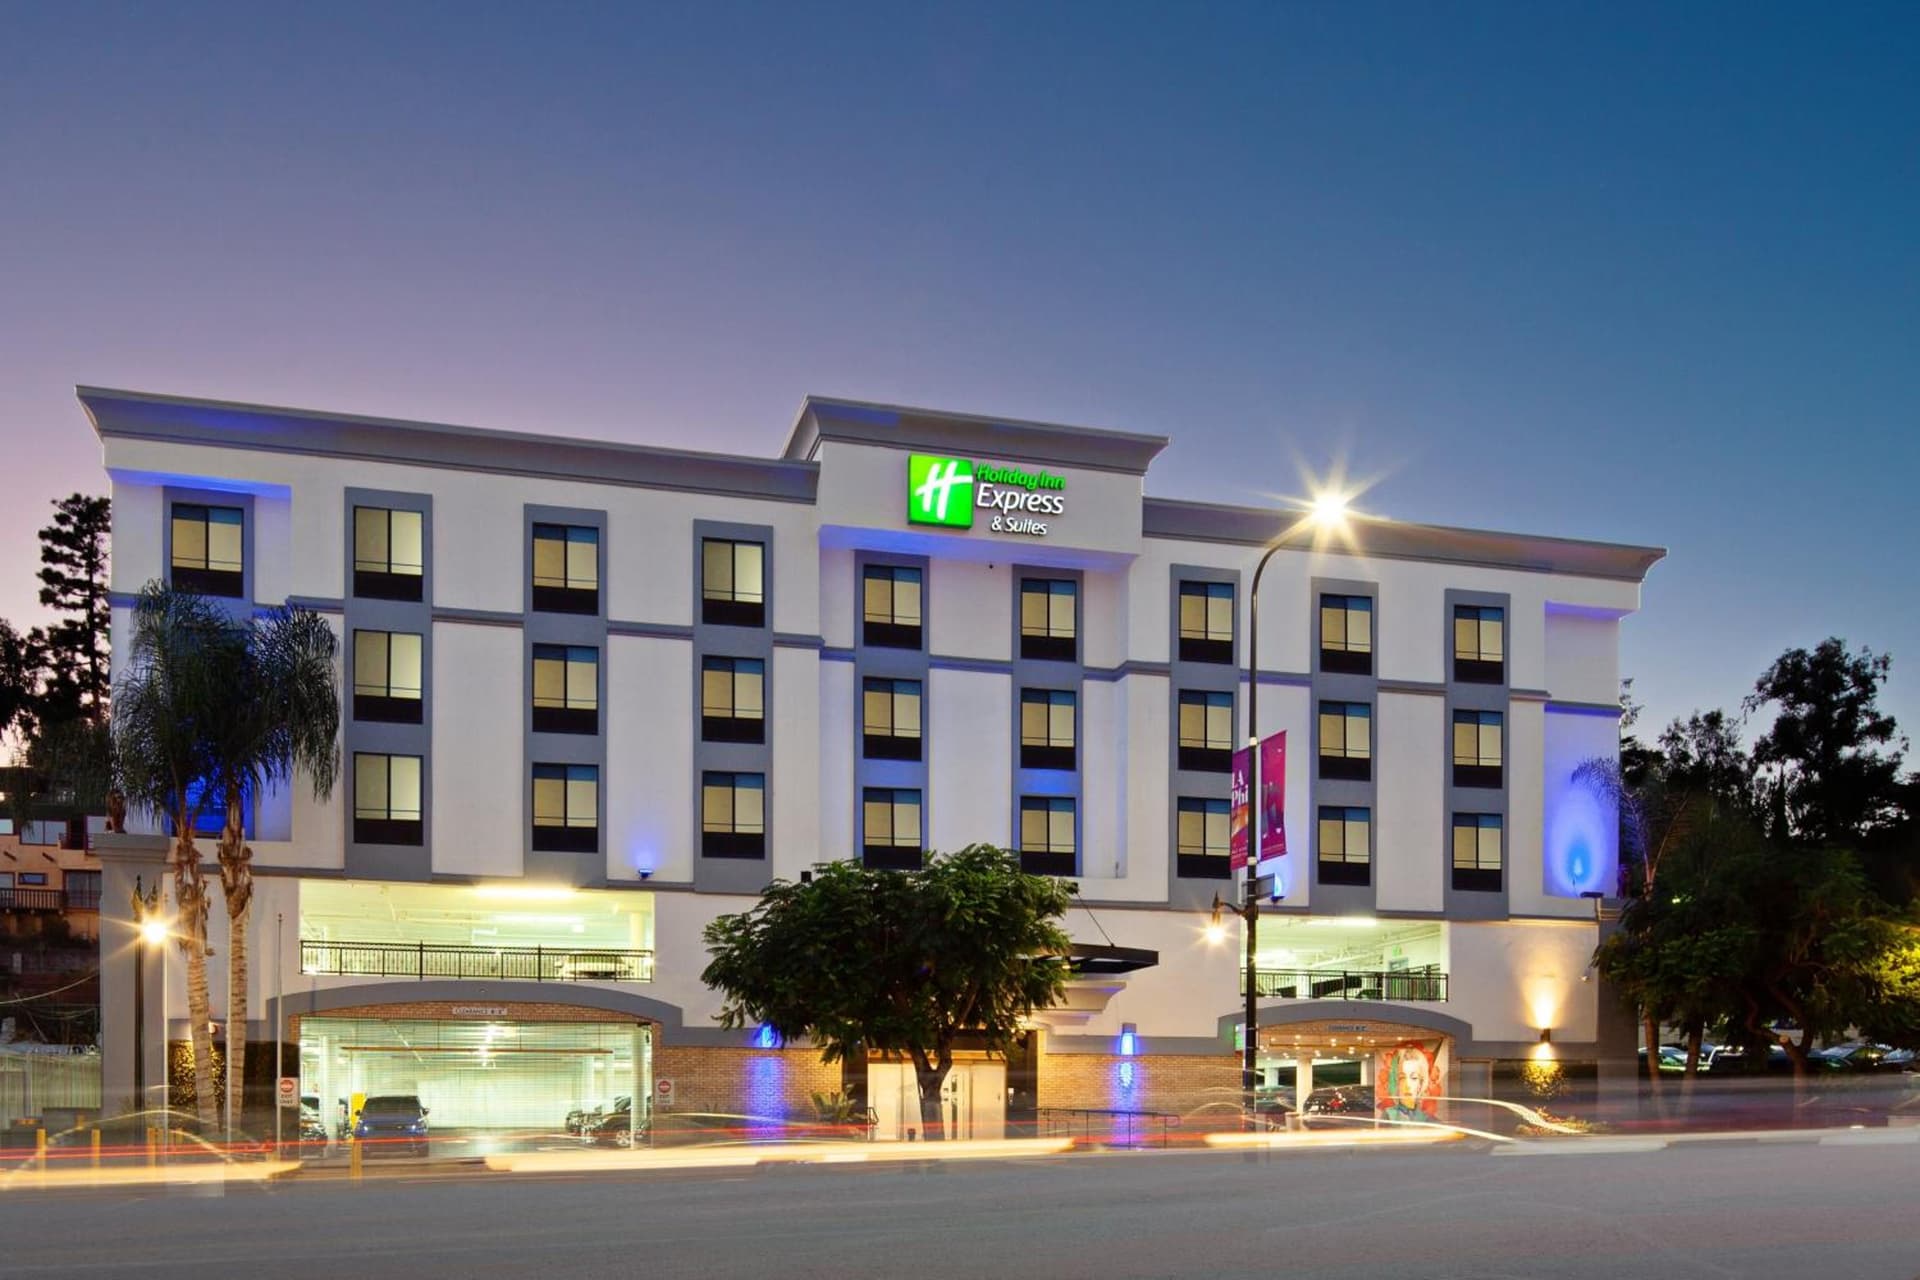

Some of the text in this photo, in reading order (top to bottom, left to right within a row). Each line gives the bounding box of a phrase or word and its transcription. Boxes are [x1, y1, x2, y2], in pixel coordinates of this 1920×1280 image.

[977, 464, 1066, 490] Holiday Inn
[977, 483, 1065, 515] Express
[991, 515, 1048, 536] & Suites
[1231, 784, 1249, 808] Phi
